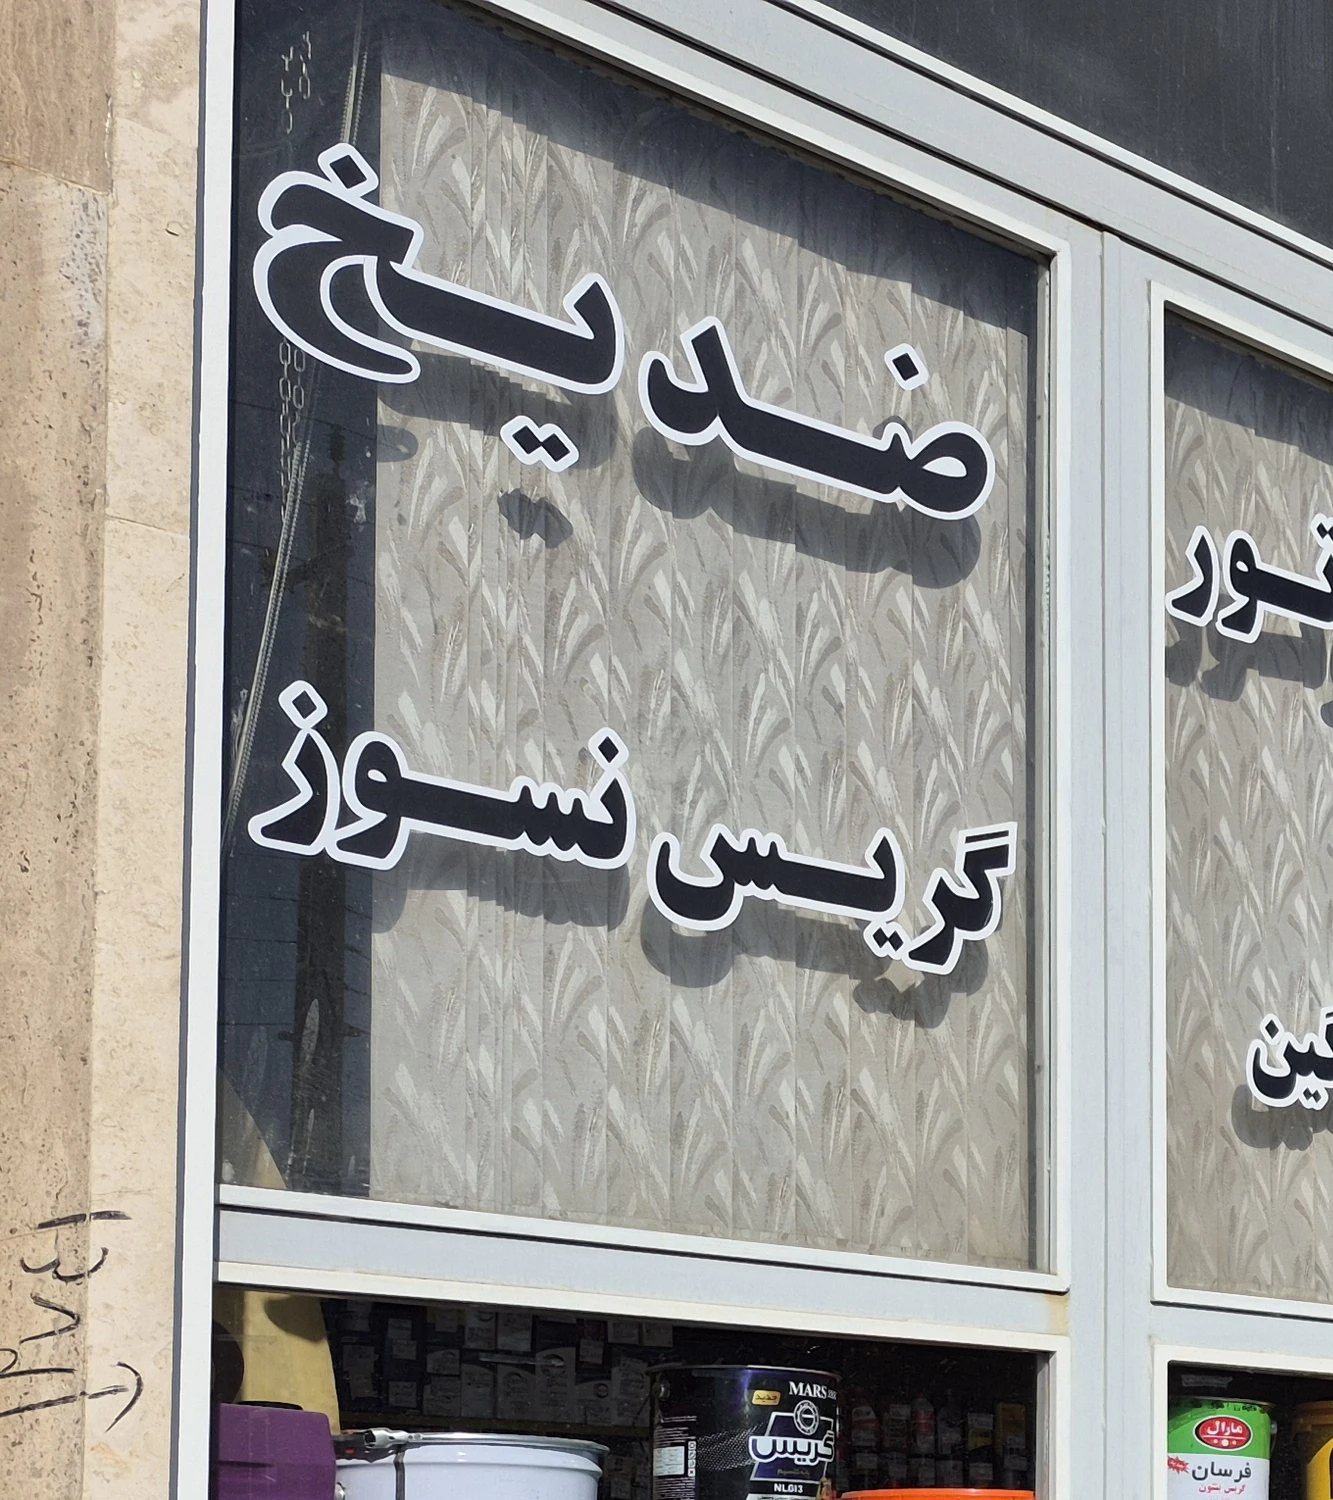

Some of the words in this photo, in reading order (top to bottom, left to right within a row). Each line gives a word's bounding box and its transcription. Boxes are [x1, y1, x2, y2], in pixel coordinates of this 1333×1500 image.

[249, 681, 636, 869] نسوز
[648, 821, 1018, 976] گریس
[789, 1381, 827, 1399] MARS
[1207, 1422, 1243, 1436] مارال
[750, 1431, 835, 1465] گریس
[1192, 1461, 1252, 1482] فرسان
